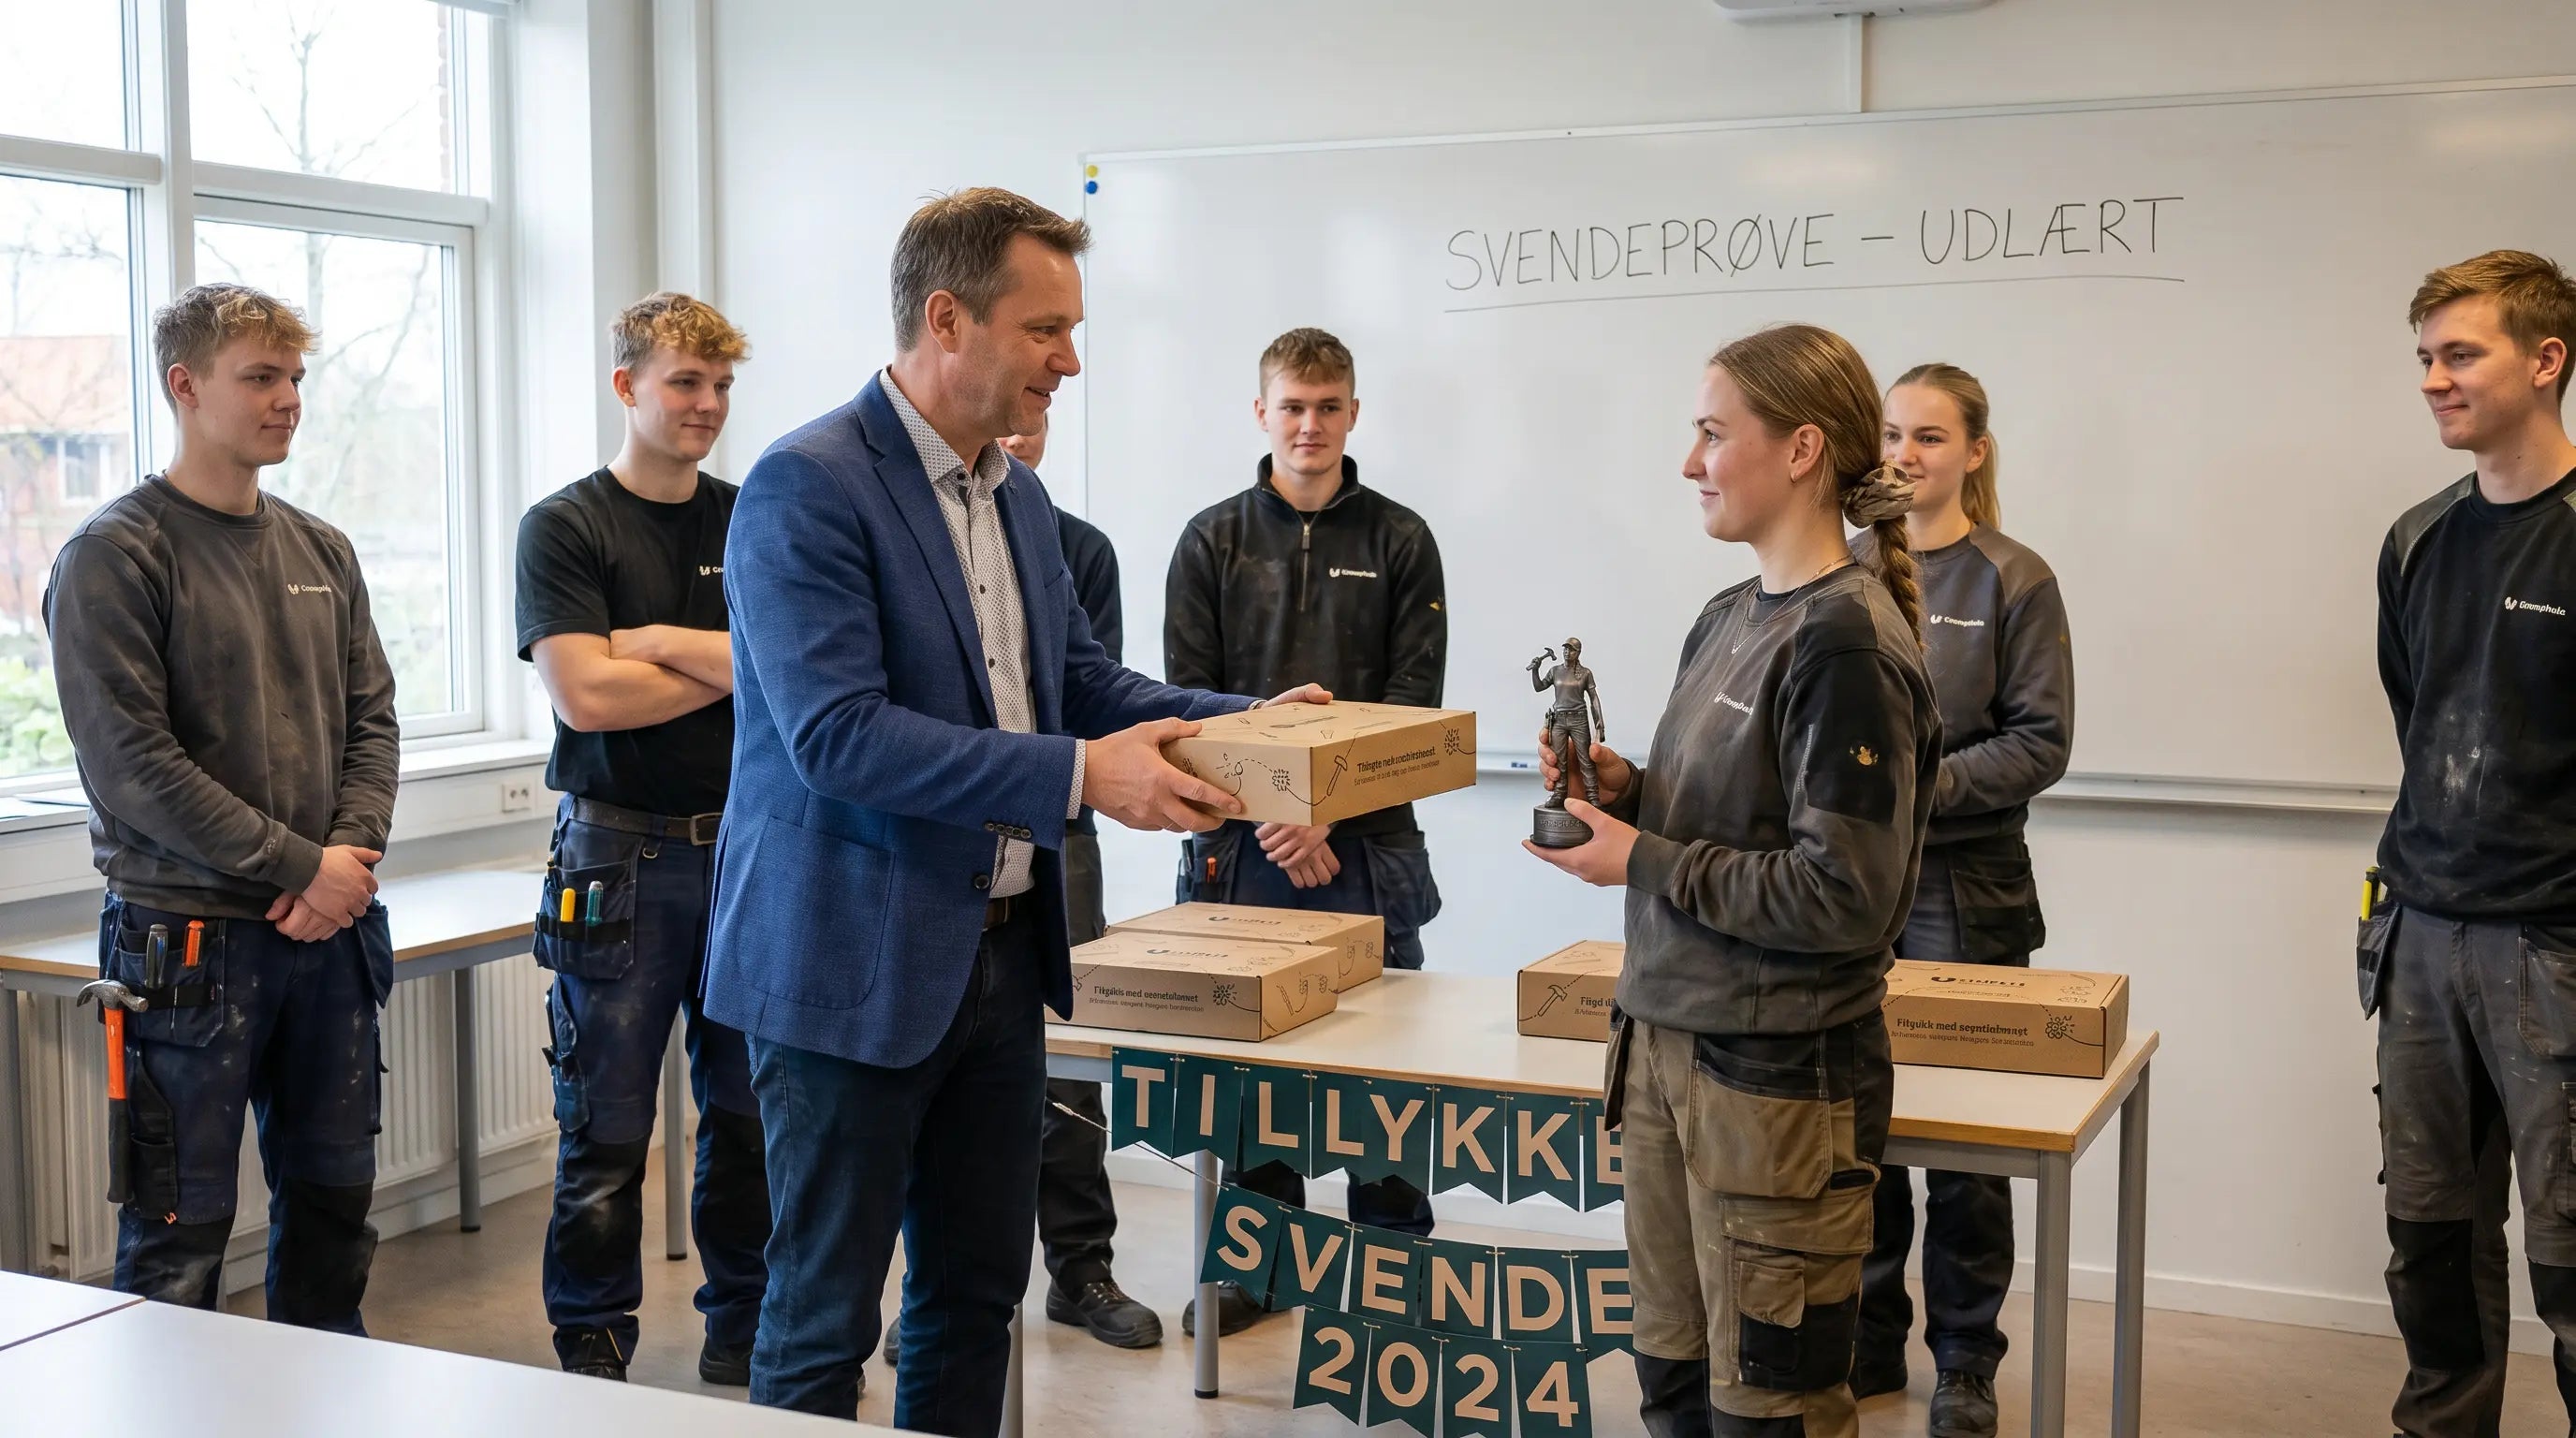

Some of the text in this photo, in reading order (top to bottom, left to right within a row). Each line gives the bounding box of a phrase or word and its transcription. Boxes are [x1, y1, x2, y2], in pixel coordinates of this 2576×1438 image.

[1444, 212, 1835, 292] SVENDEPRØVE
[1918, 196, 2185, 266] UDLÆRT
[1125, 989, 1143, 998] med
[1936, 1021, 1957, 1031] med
[1120, 1064, 1625, 1186] TILLYKKE
[1216, 1205, 1633, 1336] SVENDE
[1308, 1326, 1579, 1428] 2024
